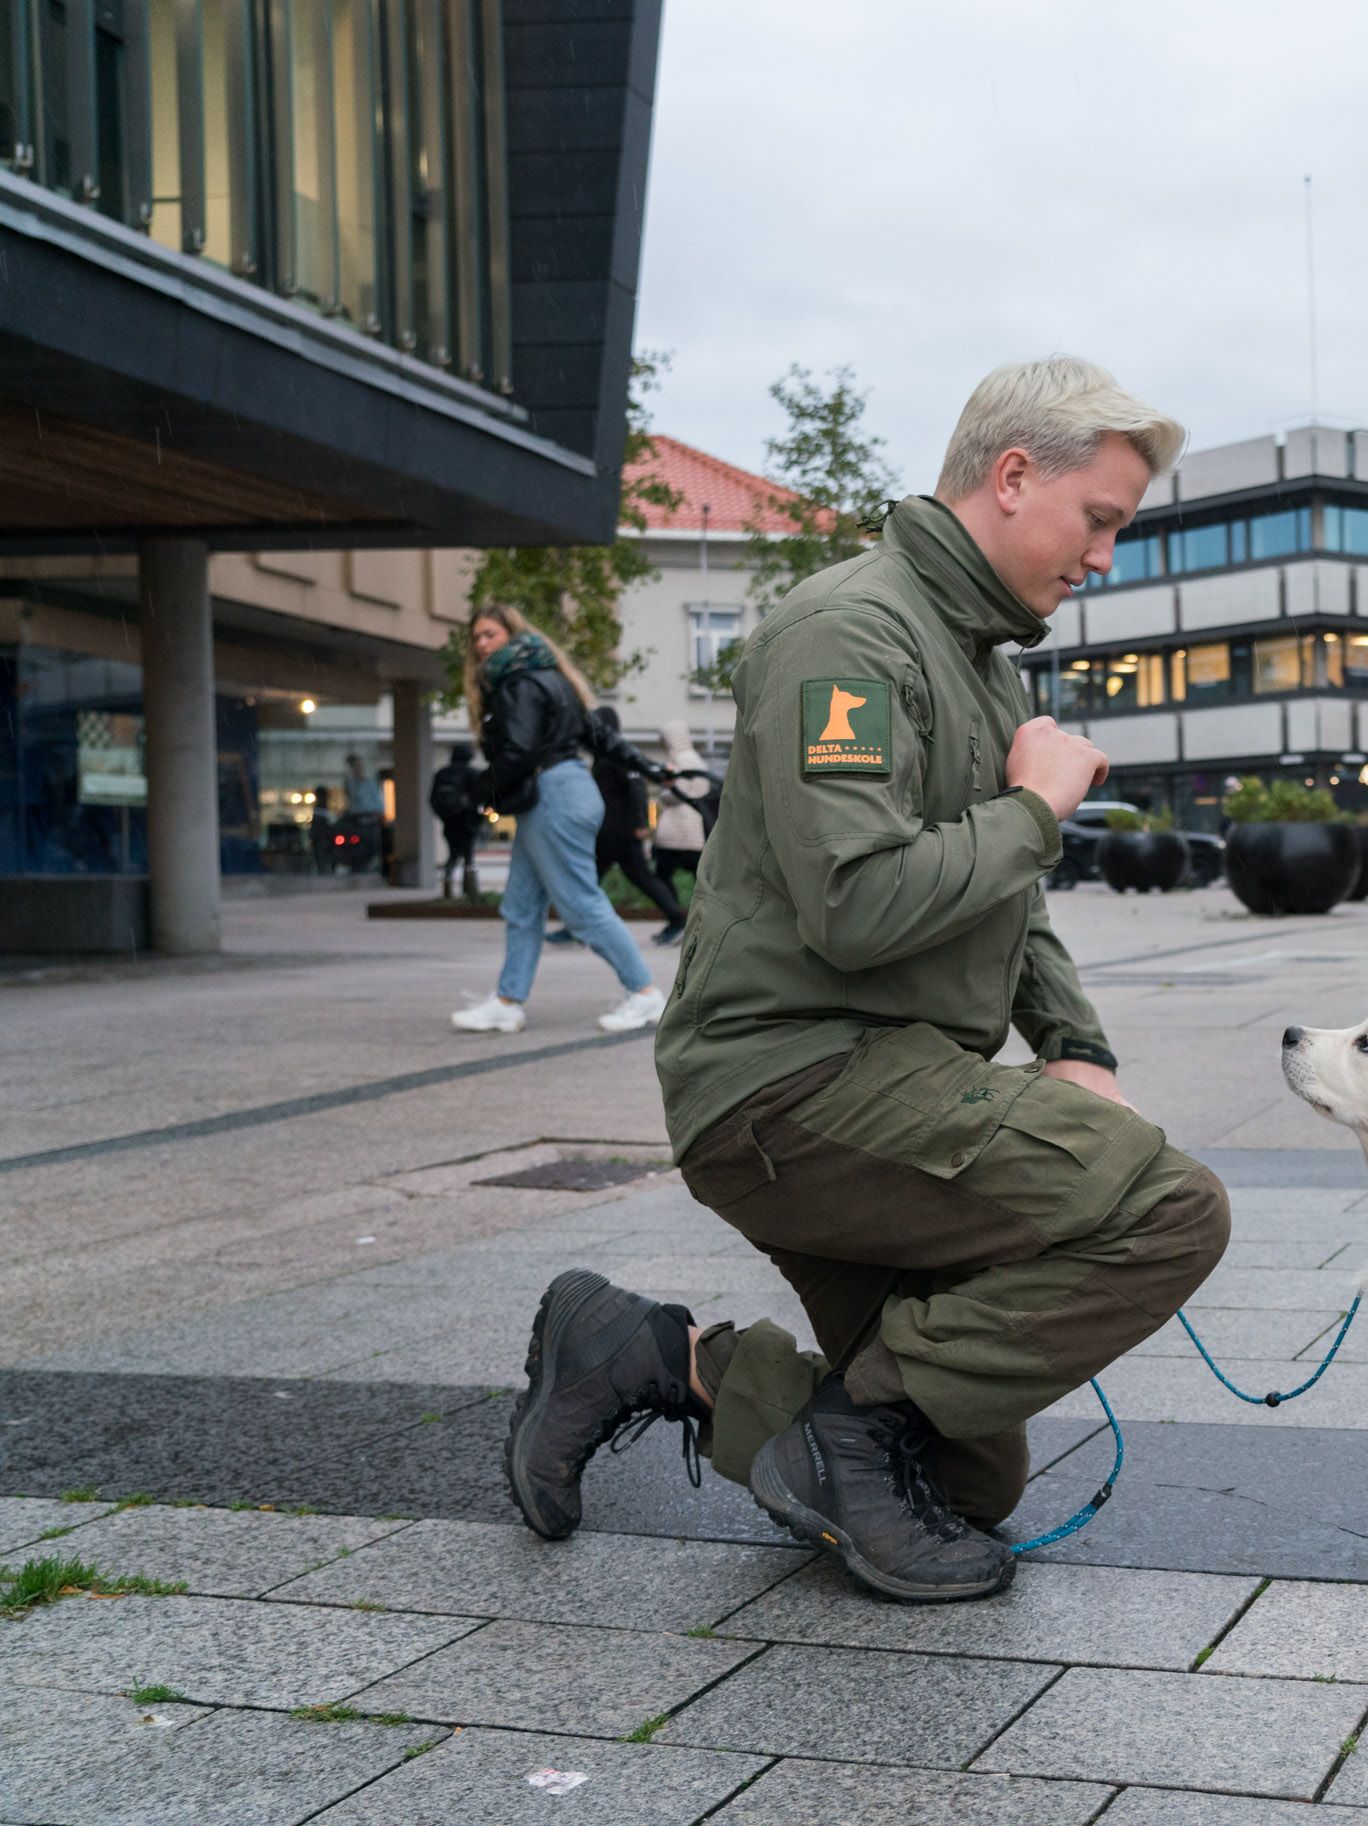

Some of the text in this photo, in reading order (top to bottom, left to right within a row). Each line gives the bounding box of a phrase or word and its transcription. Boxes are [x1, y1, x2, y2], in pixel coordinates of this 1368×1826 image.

[808, 744, 842, 754] DELTA
[808, 754, 882, 764] HUNDESKOLE
[804, 1422, 827, 1487] MERRELL
